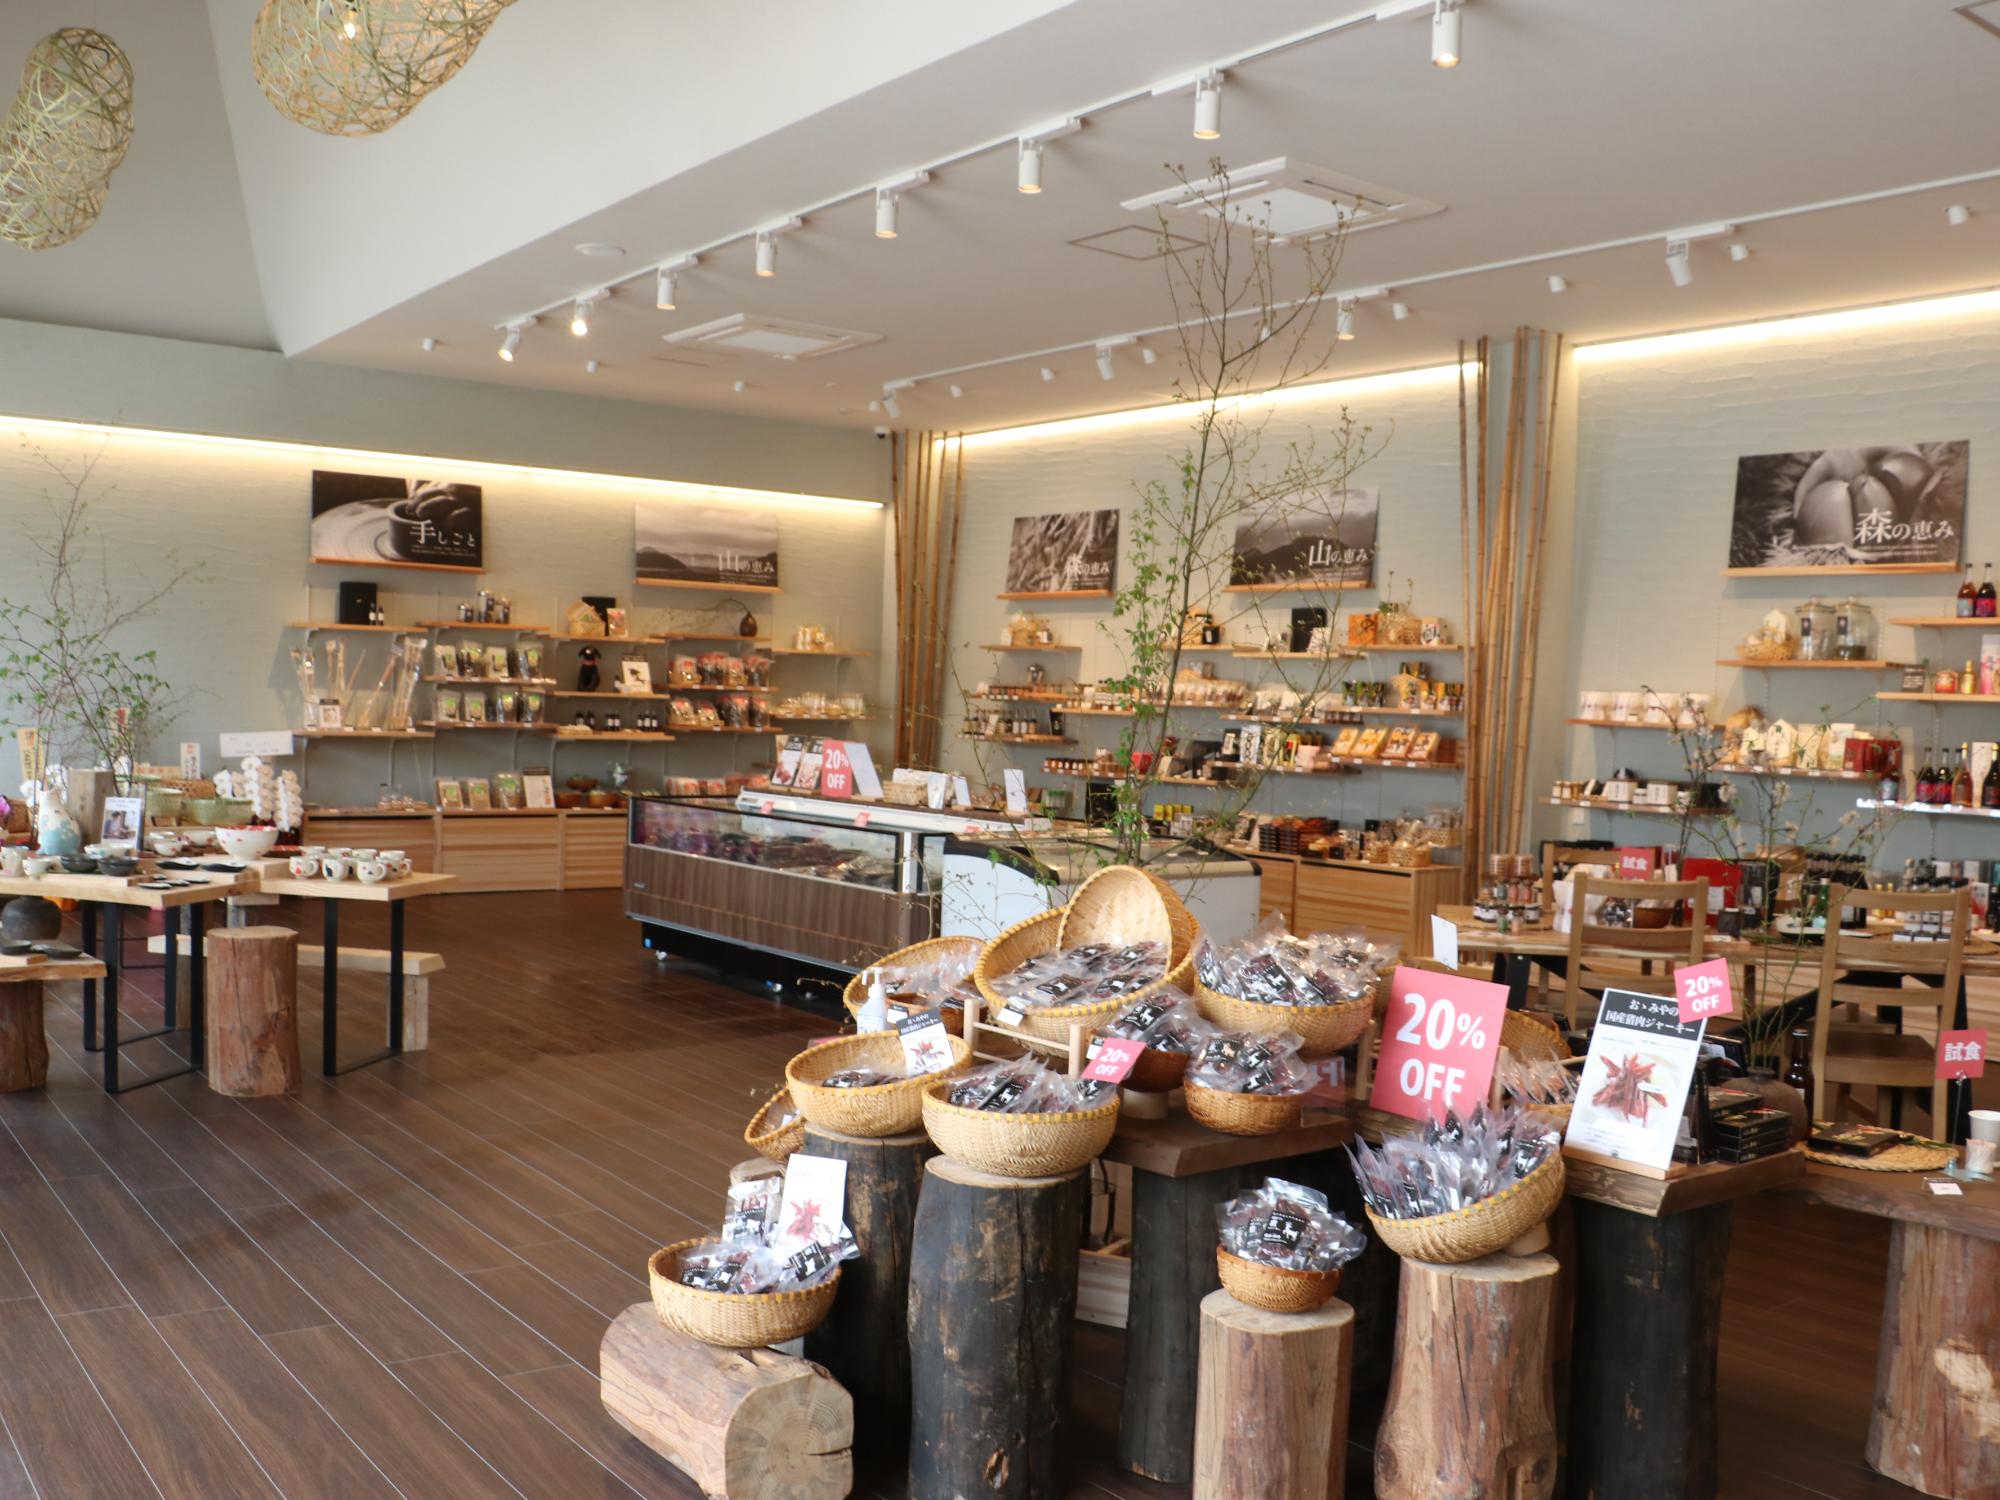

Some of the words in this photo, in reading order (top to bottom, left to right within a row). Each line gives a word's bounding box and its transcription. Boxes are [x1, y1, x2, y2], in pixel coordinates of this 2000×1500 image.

[409, 519, 476, 547] 手しごと
[1854, 508, 1954, 544] 森の恵み
[1308, 539, 1369, 566] 山の恵み
[825, 748, 849, 770] 20%
[827, 773, 845, 789] OFF
[1684, 976, 1723, 998] 20%
[1691, 994, 1719, 1013] OFF
[1396, 992, 1486, 1050] 20%
[1099, 1047, 1131, 1063] 20%
[1944, 1041, 1982, 1062] 試食
[1094, 1064, 1120, 1076] OFF
[1400, 1058, 1465, 1107] OFF
